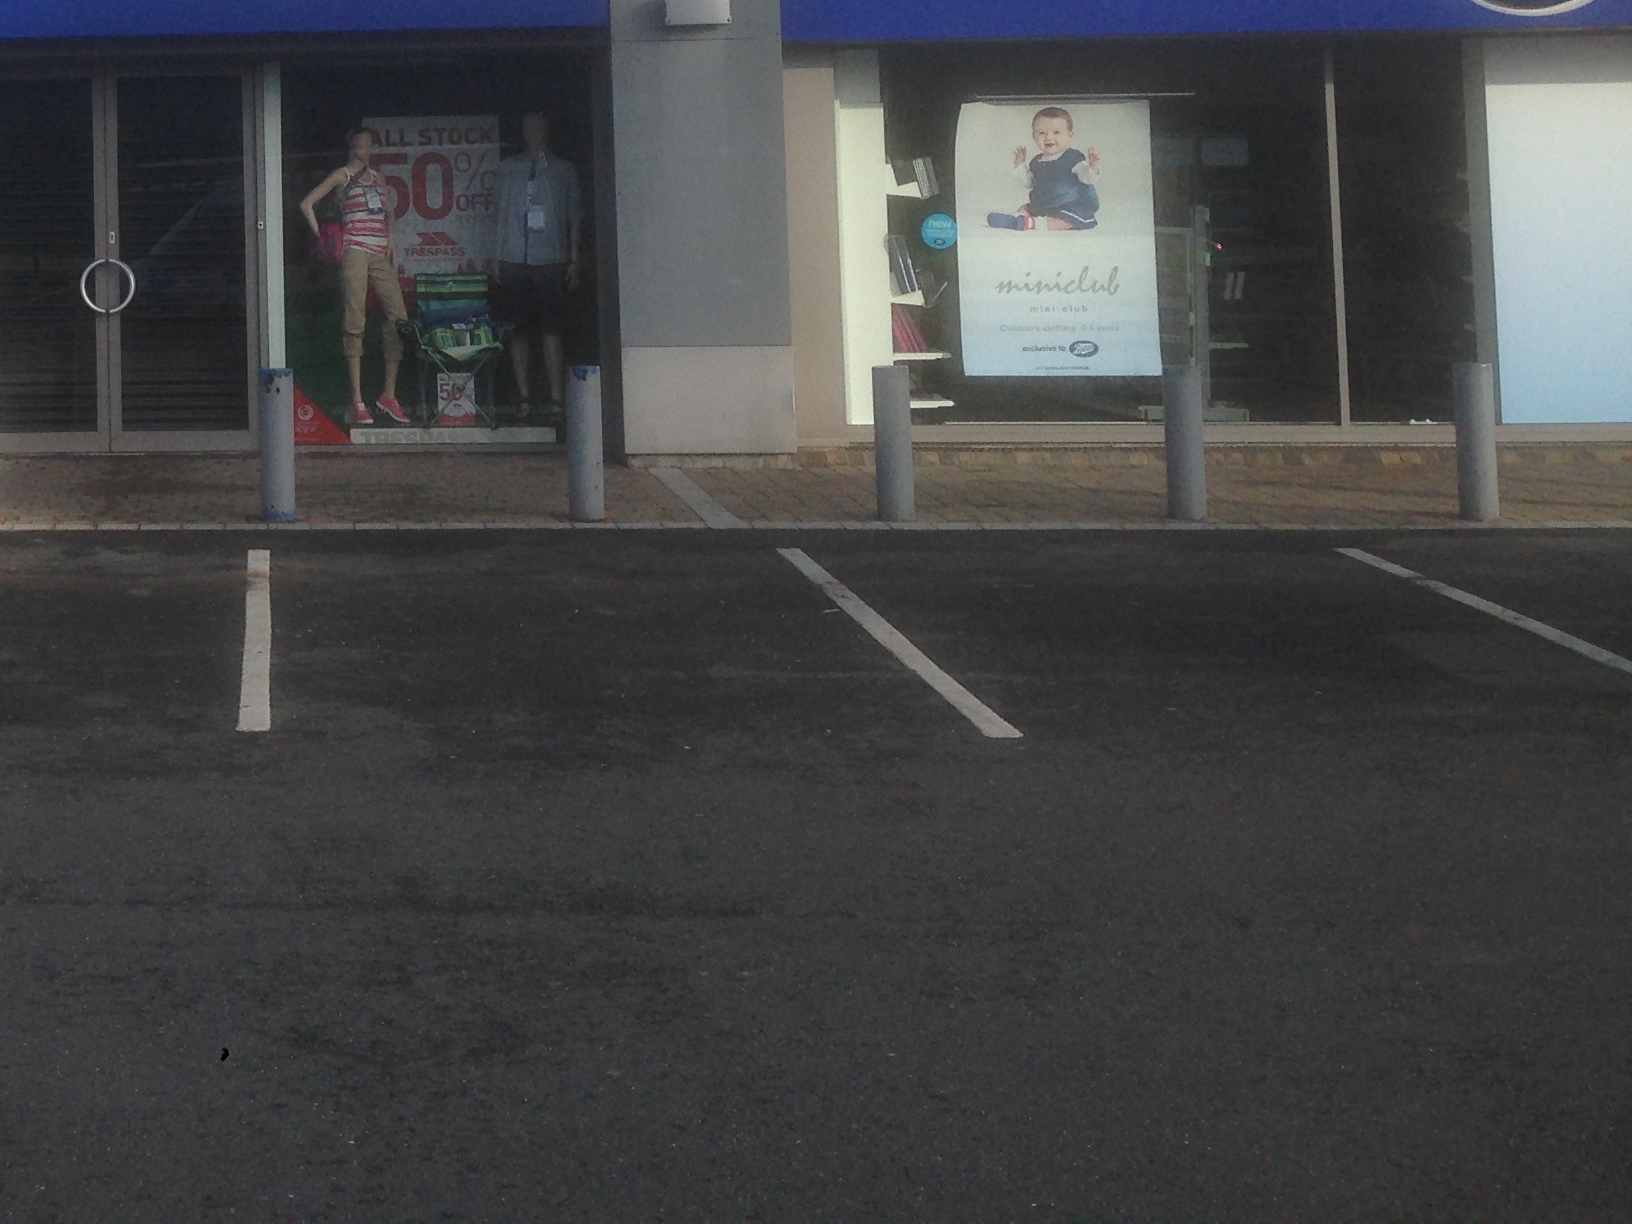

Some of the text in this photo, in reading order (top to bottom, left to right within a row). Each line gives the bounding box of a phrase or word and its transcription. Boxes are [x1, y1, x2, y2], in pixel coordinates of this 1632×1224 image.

[370, 127, 494, 147] ALL STOCK
[455, 193, 492, 212] OFF
[404, 246, 466, 257] TRESPASS
[995, 265, 1120, 296] miniclub
[1062, 305, 1088, 313] club
